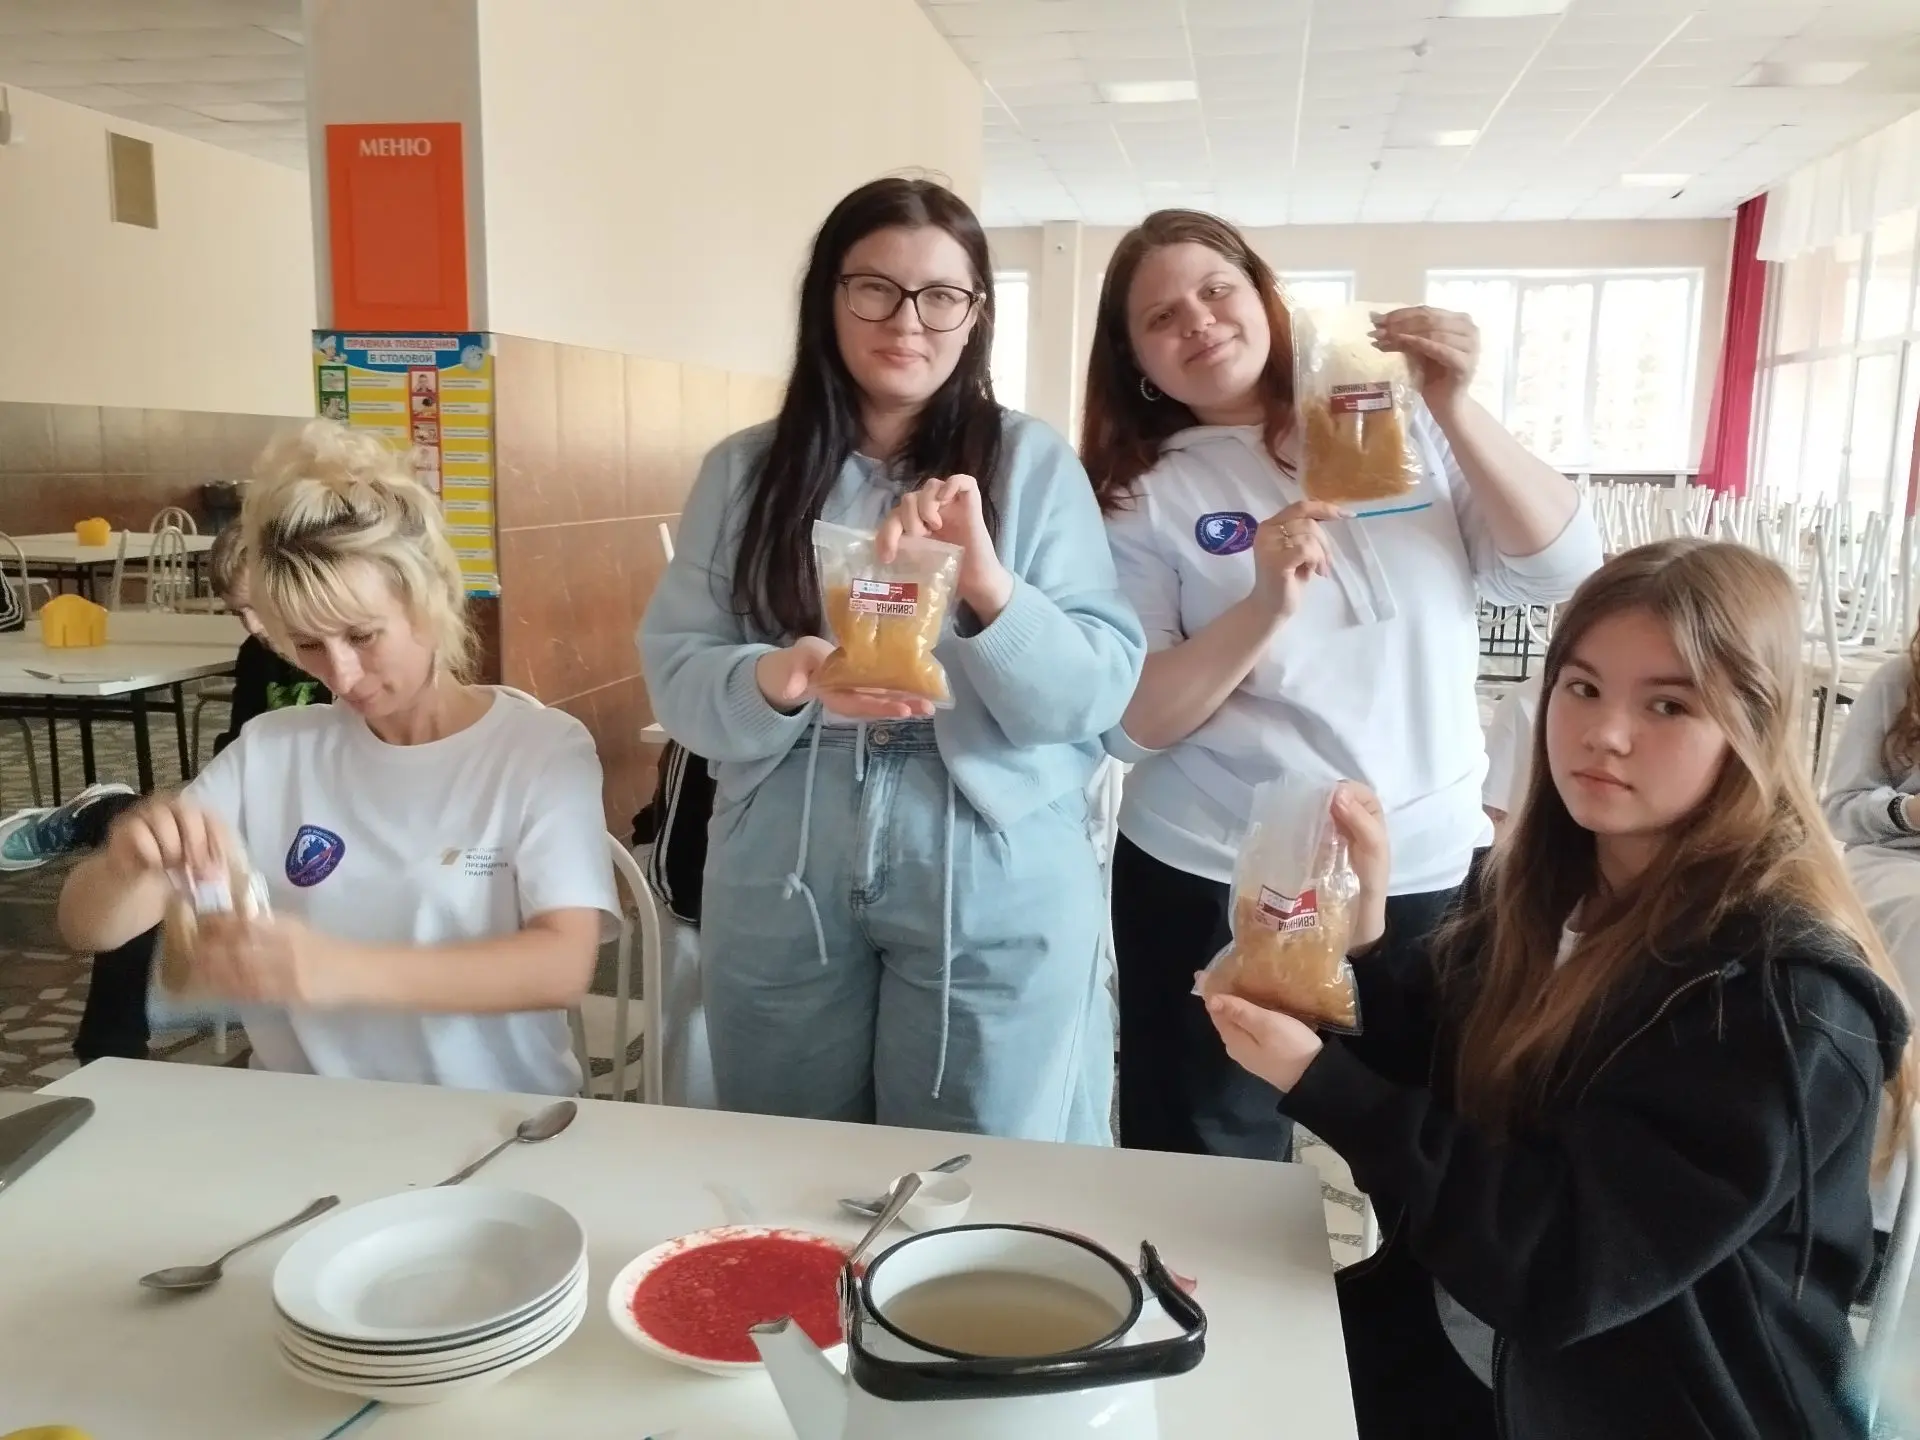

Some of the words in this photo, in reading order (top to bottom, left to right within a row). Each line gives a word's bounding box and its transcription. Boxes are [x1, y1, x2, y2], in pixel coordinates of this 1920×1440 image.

[359, 137, 432, 157] МЕНЮ
[346, 337, 394, 349] ПРАВИЛА
[395, 338, 458, 350] ПОВЕДЕНИЯ
[369, 352, 375, 363] В
[379, 352, 433, 364] СТОЛОВОЙ
[876, 602, 914, 615] СВИНИНА
